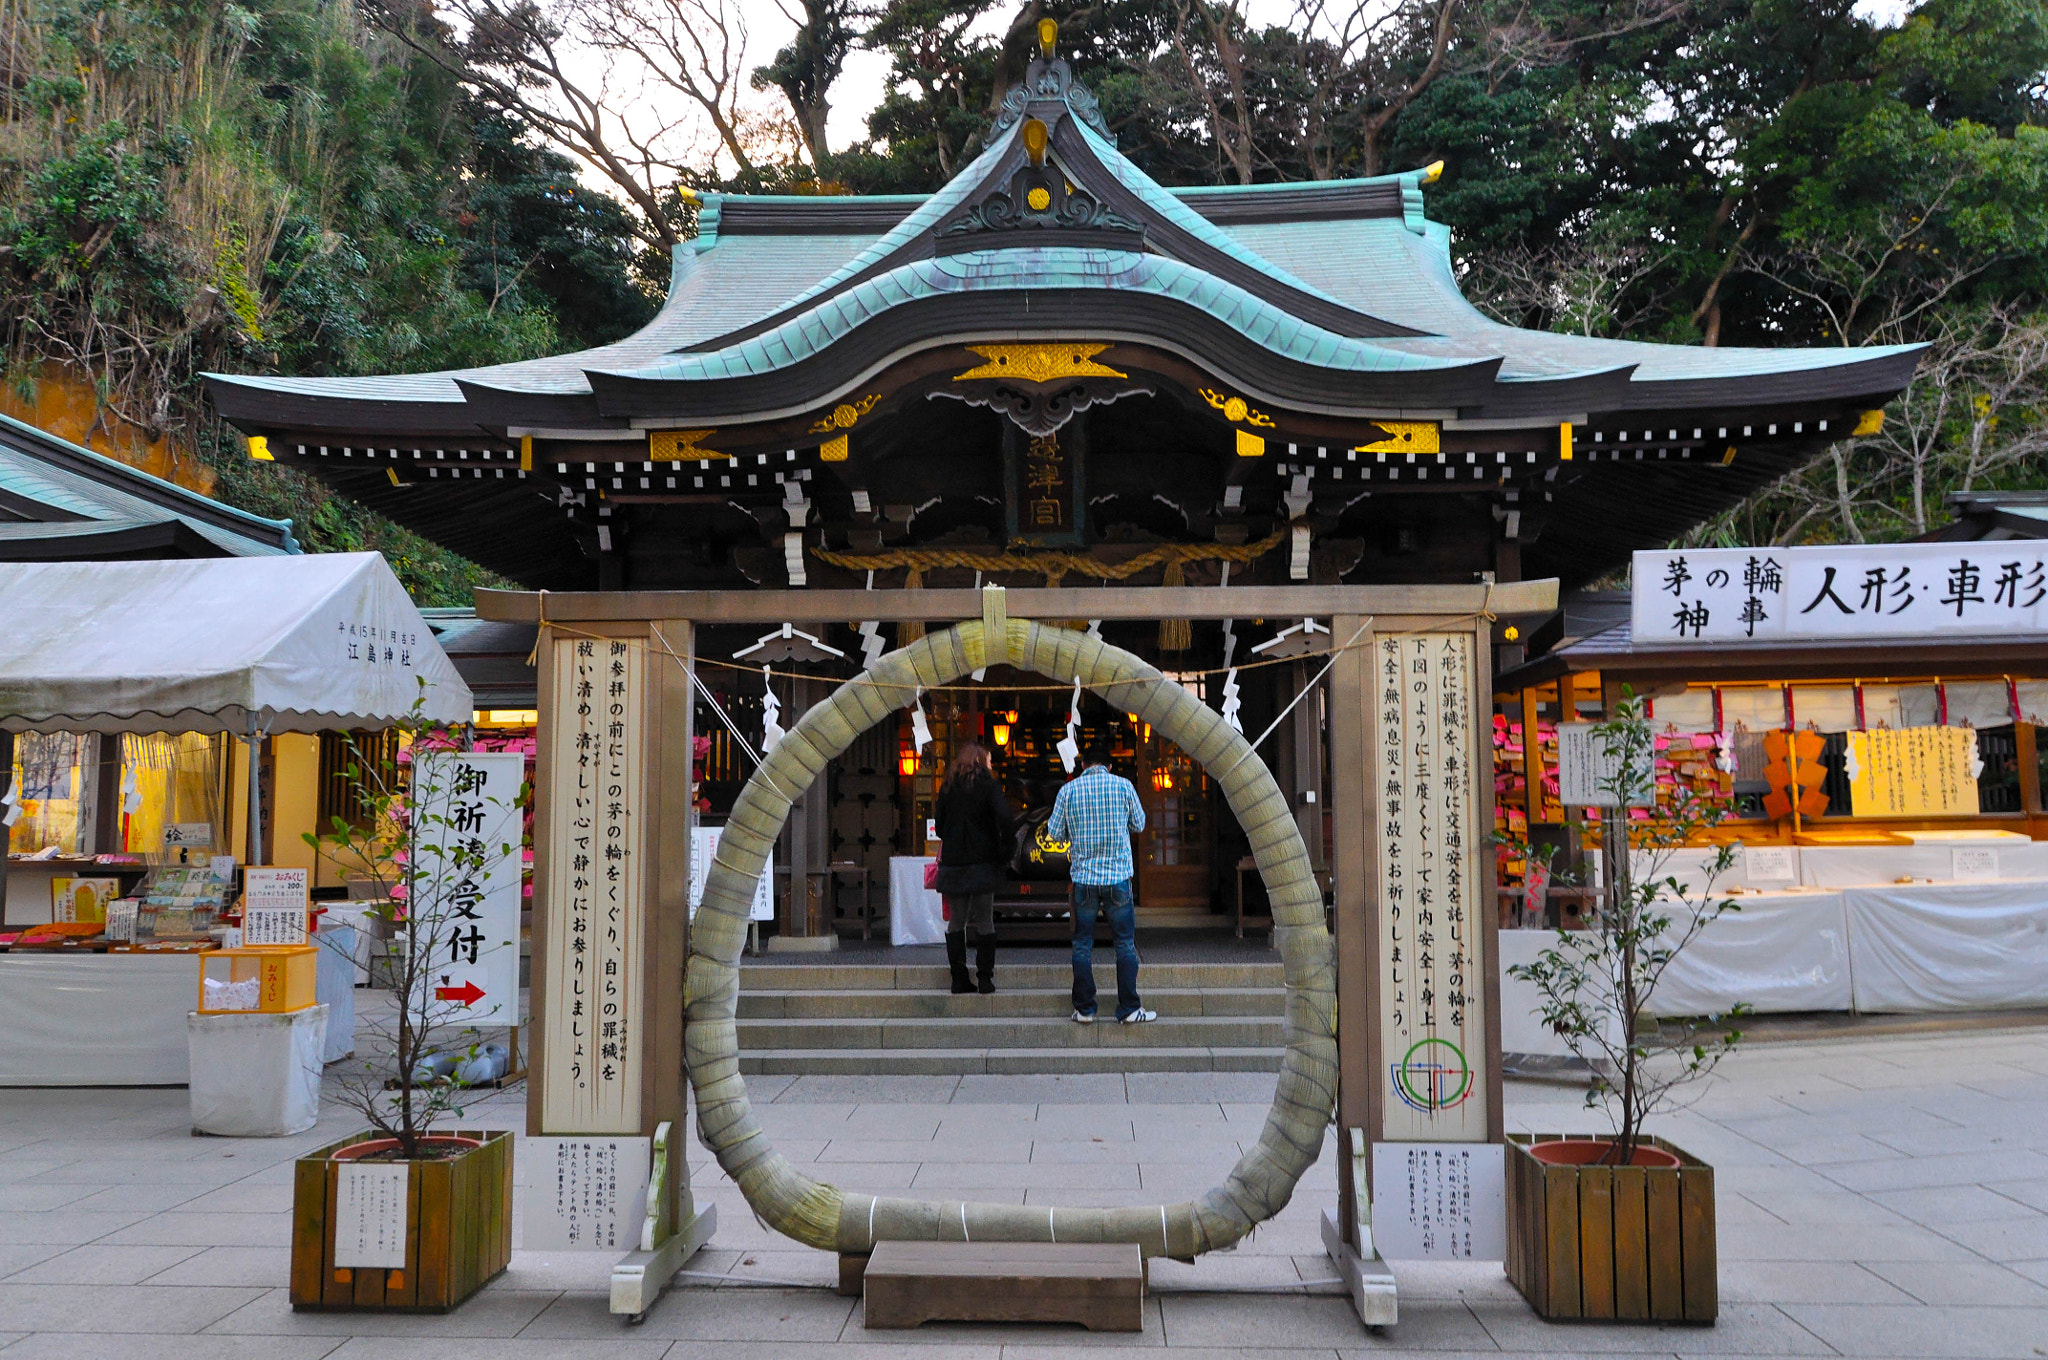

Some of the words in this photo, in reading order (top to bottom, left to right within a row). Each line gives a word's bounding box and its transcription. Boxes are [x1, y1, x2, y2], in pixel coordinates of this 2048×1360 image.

[1661, 555, 1784, 597] 茅の輪
[1800, 558, 2047, 617] 人形・車形
[1670, 596, 1770, 638] 神事
[347, 642, 411, 667] 江島神社
[1381, 637, 1408, 1036] 安全・無病息災・無事故をお祈りしましょう。
[1411, 638, 1436, 1027] 下図のように三度くぐって家内安全・身上
[268, 964, 278, 1002] おみくじ
